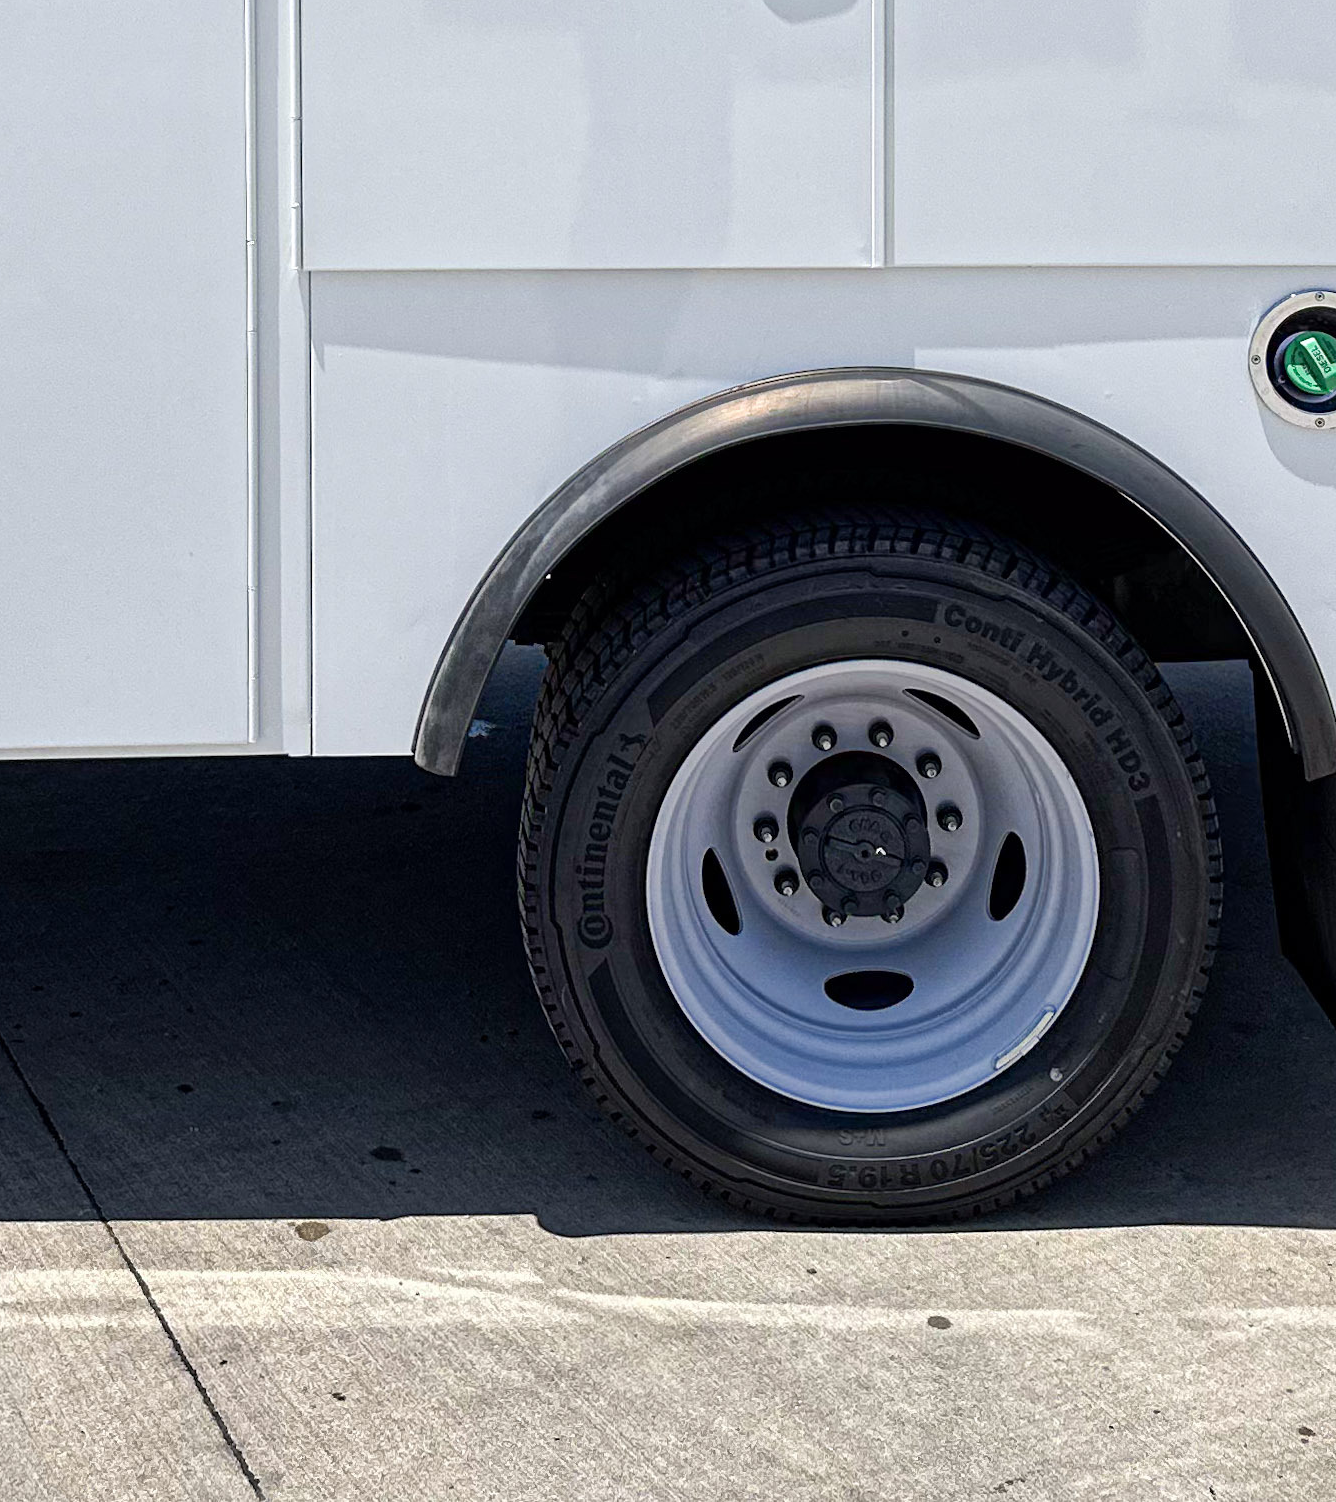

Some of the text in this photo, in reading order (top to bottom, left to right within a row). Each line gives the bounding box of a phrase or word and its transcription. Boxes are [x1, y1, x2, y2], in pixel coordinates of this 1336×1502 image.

[1311, 344, 1332, 374] DIESEL
[943, 603, 1026, 654] Conti
[1026, 641, 1115, 729] Hybrid
[1105, 727, 1151, 792] HD3
[576, 752, 637, 950] Continental
[929, 1122, 1036, 1181] 225/70
